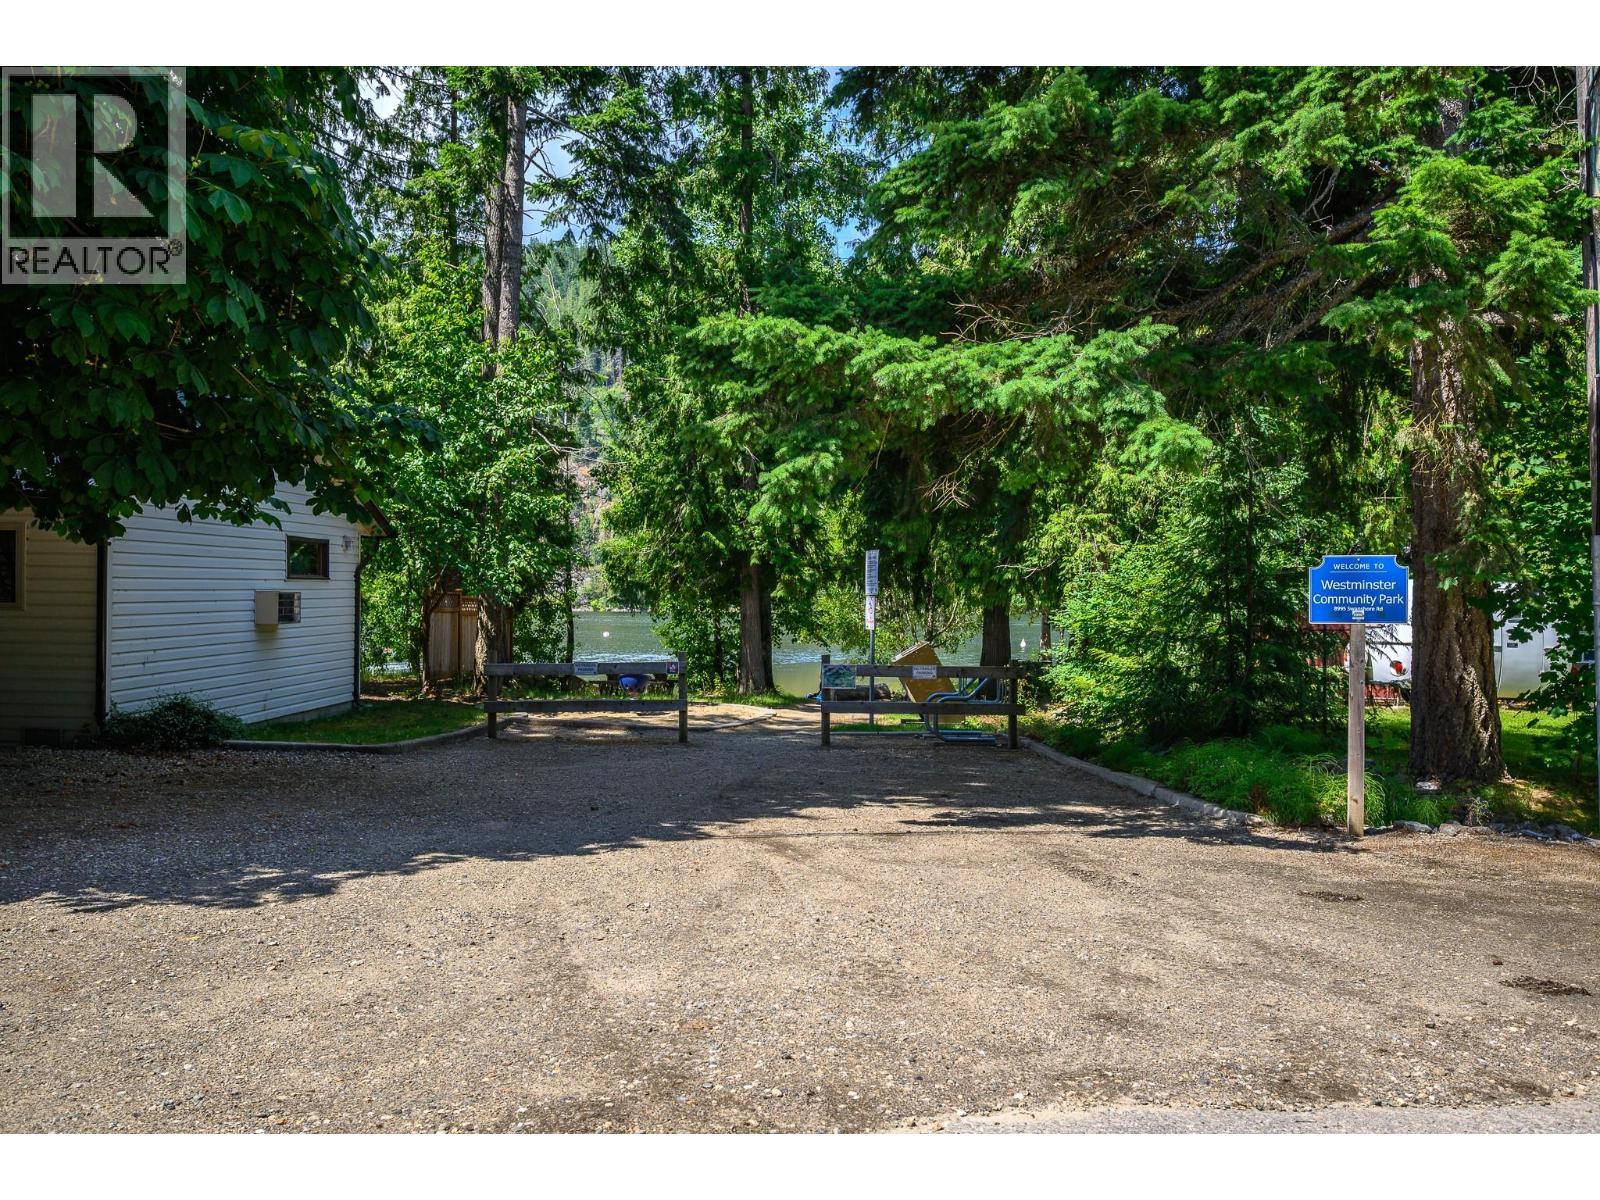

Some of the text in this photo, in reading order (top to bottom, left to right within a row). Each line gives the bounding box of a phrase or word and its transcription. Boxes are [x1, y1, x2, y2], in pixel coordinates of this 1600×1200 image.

[1321, 580, 1396, 590] Westminster
[1313, 594, 1404, 606] Community Park
